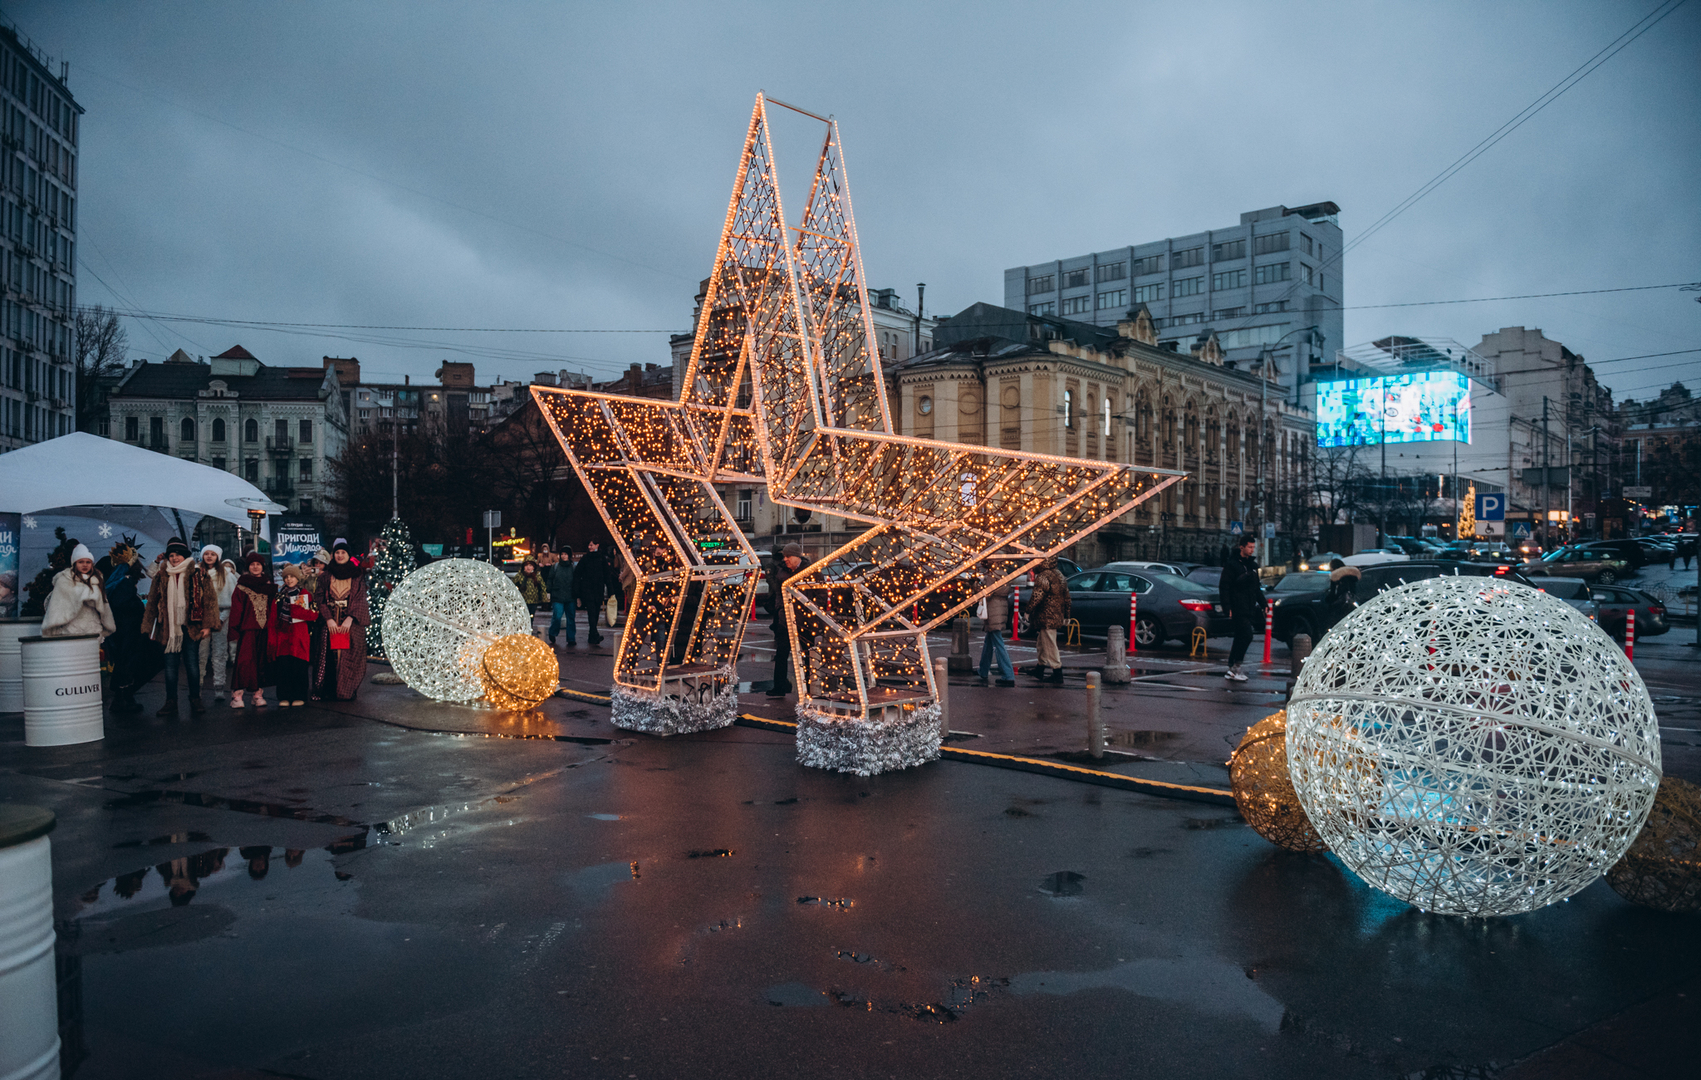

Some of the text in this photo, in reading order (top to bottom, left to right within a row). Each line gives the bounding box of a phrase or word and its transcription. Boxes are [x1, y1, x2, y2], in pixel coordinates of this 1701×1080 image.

[1482, 496, 1499, 518] P
[277, 532, 320, 543] ПРИГОДИ
[55, 683, 100, 697] GULLIVER
